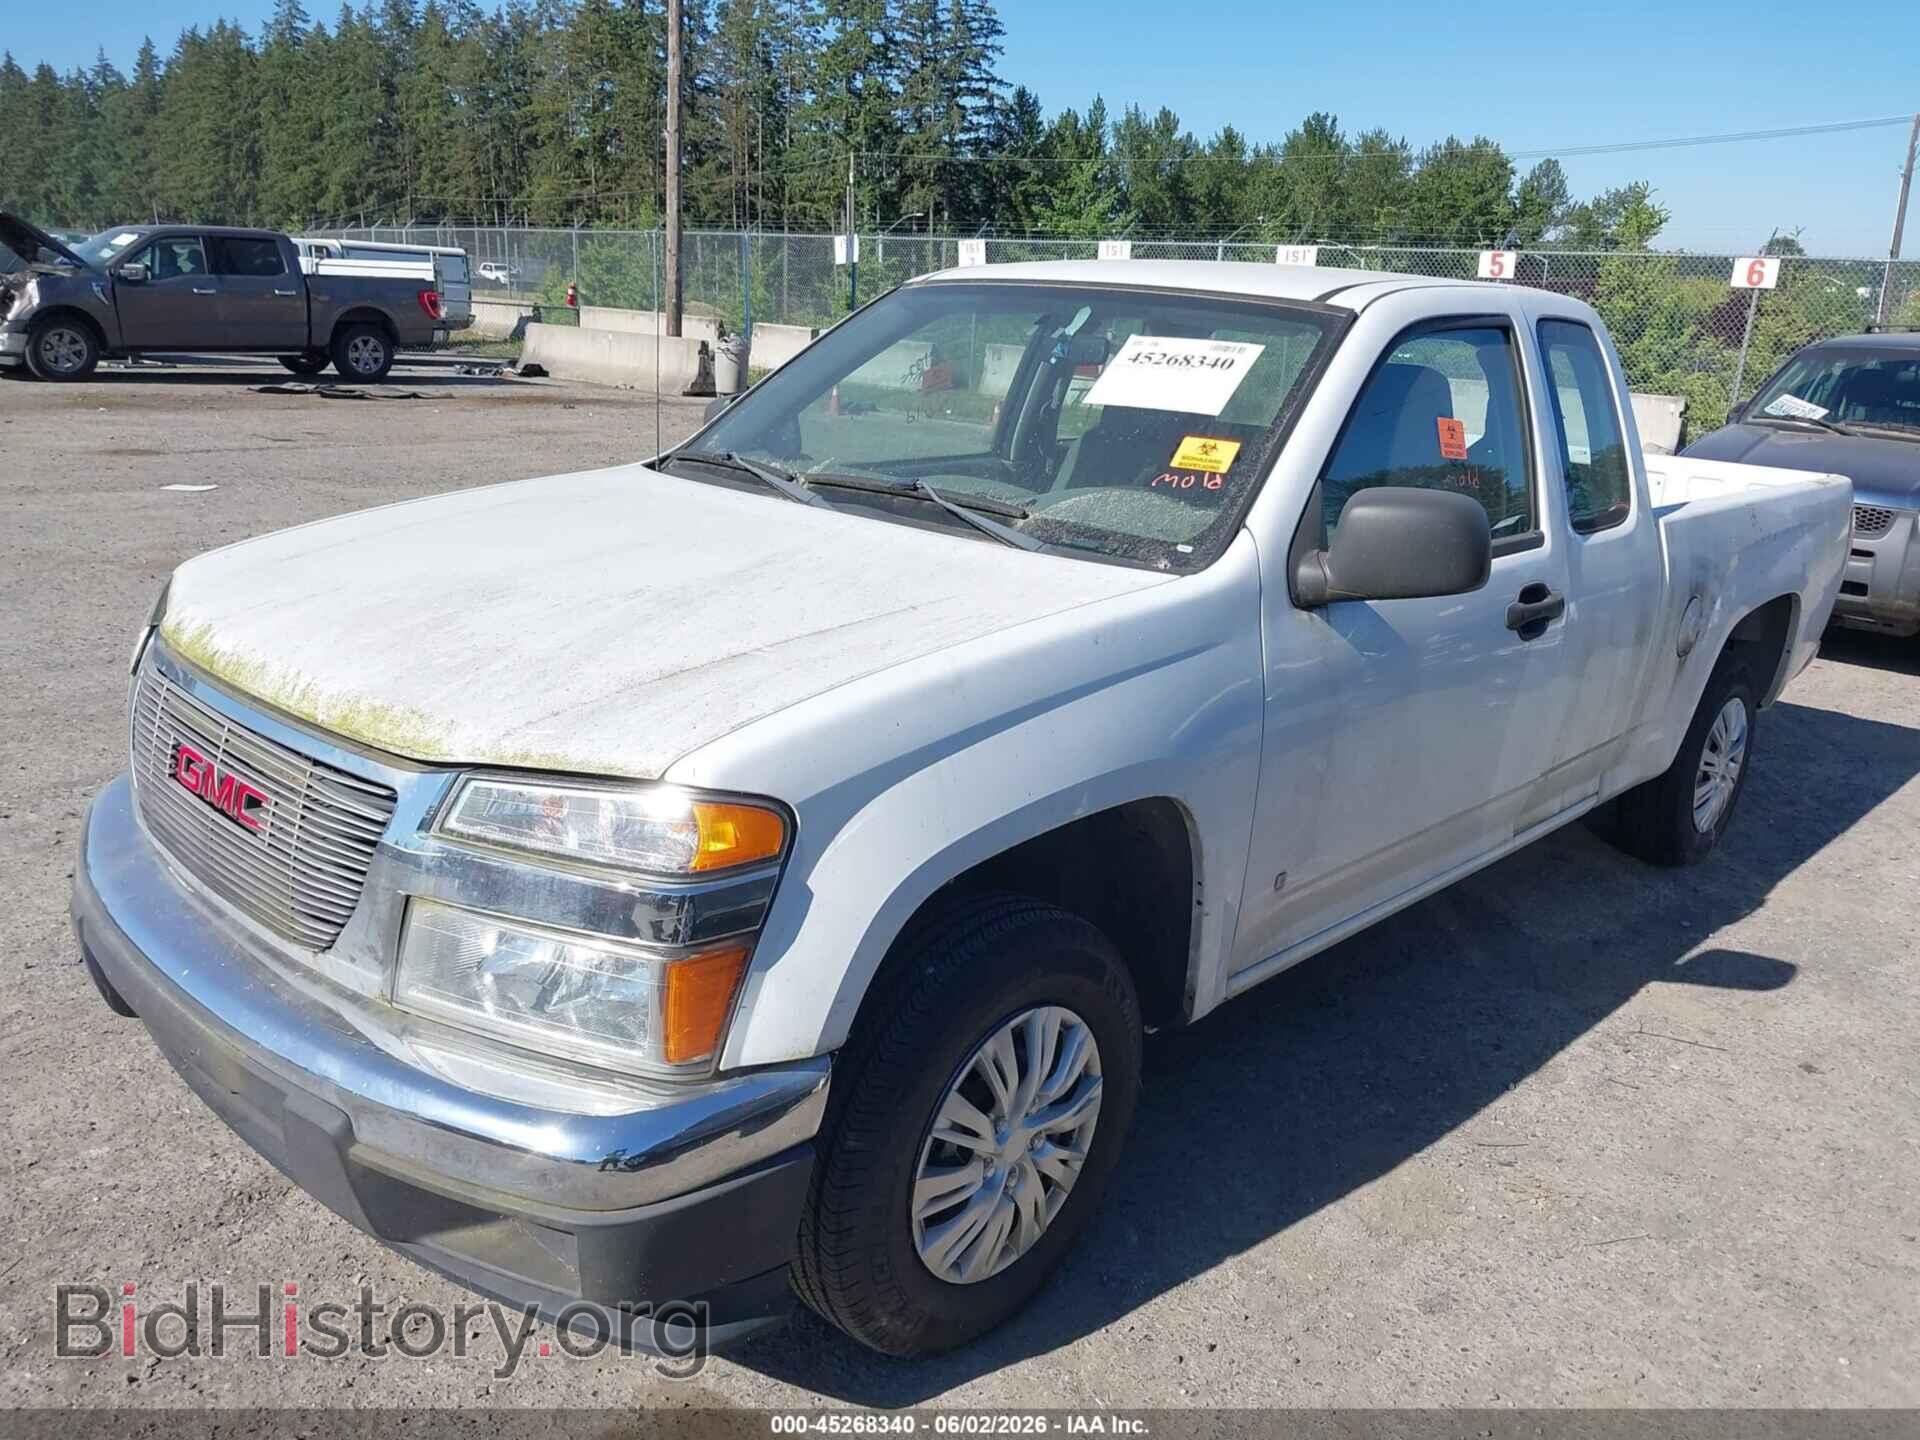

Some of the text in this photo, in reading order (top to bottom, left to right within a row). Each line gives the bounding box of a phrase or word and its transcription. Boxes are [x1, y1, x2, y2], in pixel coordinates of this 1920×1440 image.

[1490, 252, 1505, 277] 5
[1746, 259, 1766, 287] 6
[1127, 351, 1236, 370] 45268340
[176, 743, 271, 833] GMC
